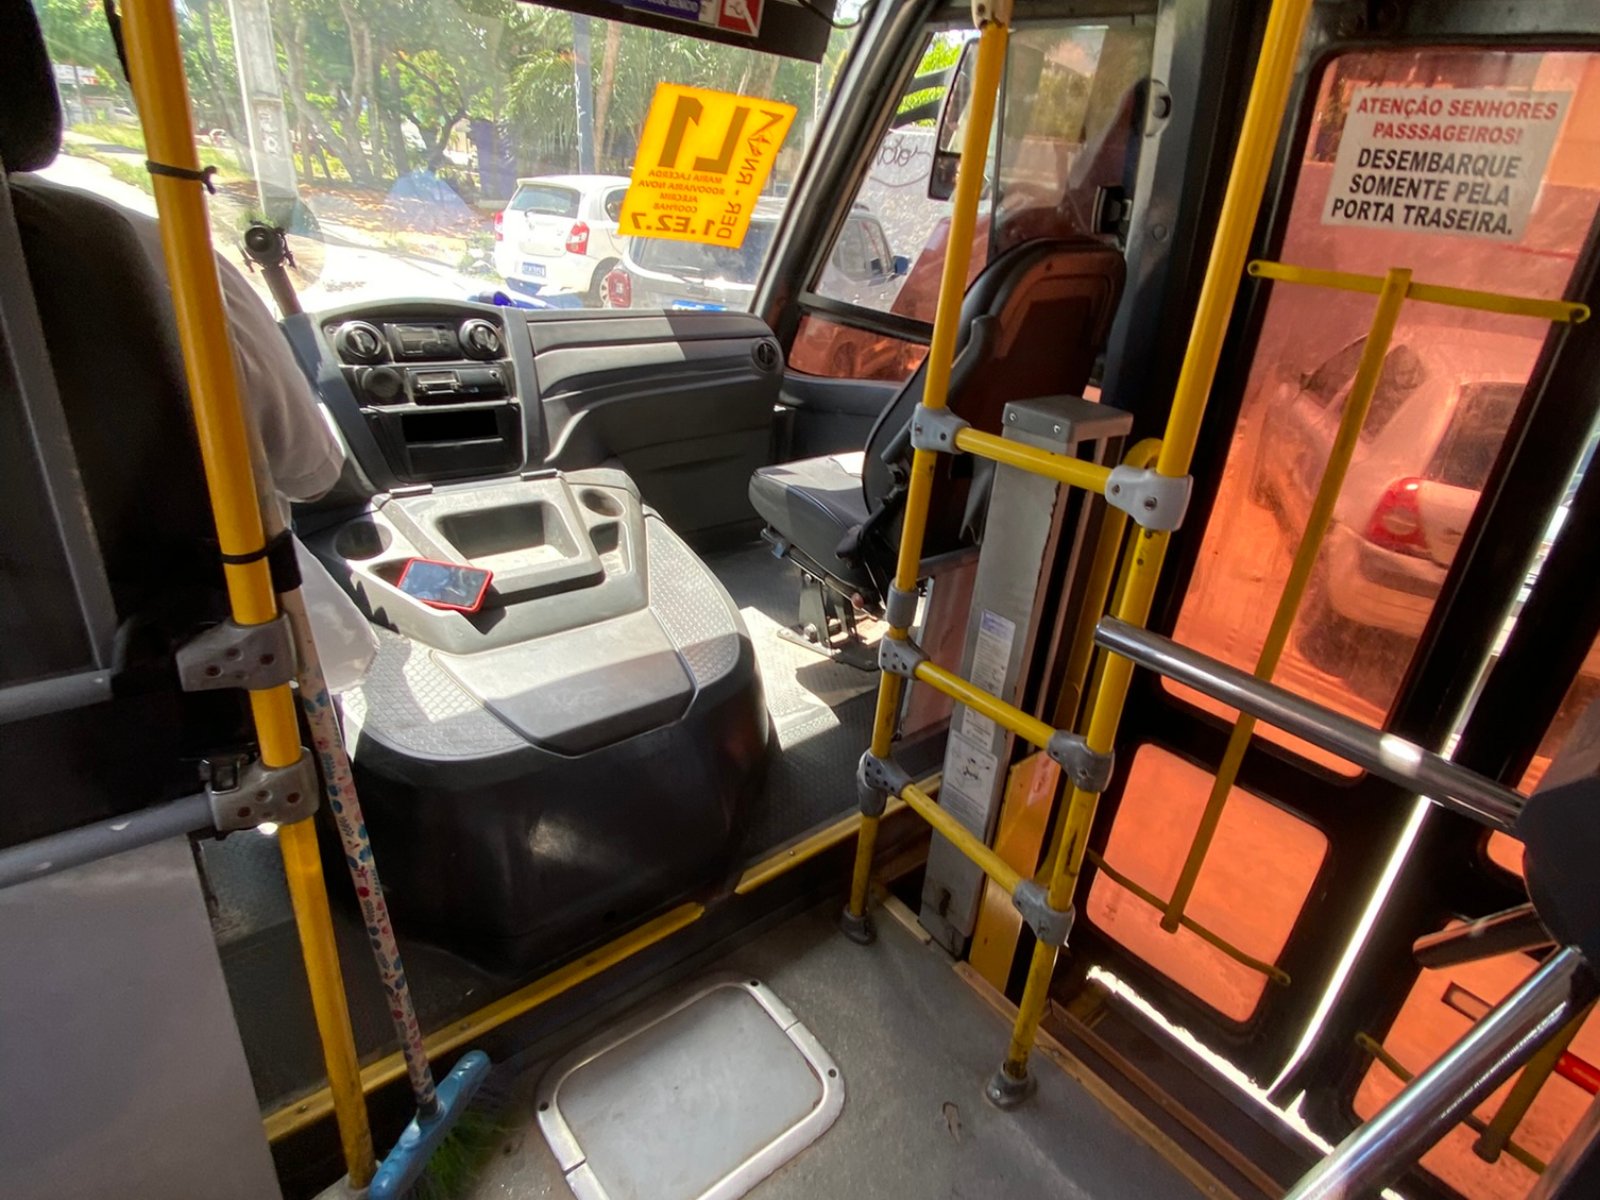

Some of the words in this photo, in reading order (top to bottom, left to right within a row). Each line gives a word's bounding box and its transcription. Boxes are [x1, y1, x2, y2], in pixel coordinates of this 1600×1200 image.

[1356, 96, 1443, 119] ATENÇÃO
[1447, 100, 1558, 120] SENHORES
[1372, 122, 1523, 145] PASSSAGEIROS!
[1357, 149, 1522, 179] DESEMBARQUE
[1349, 174, 1450, 202] SOMENTE
[1453, 184, 1510, 206] PELA
[1331, 199, 1394, 223] PORTA
[1403, 204, 1513, 235] TRASEIRA.
